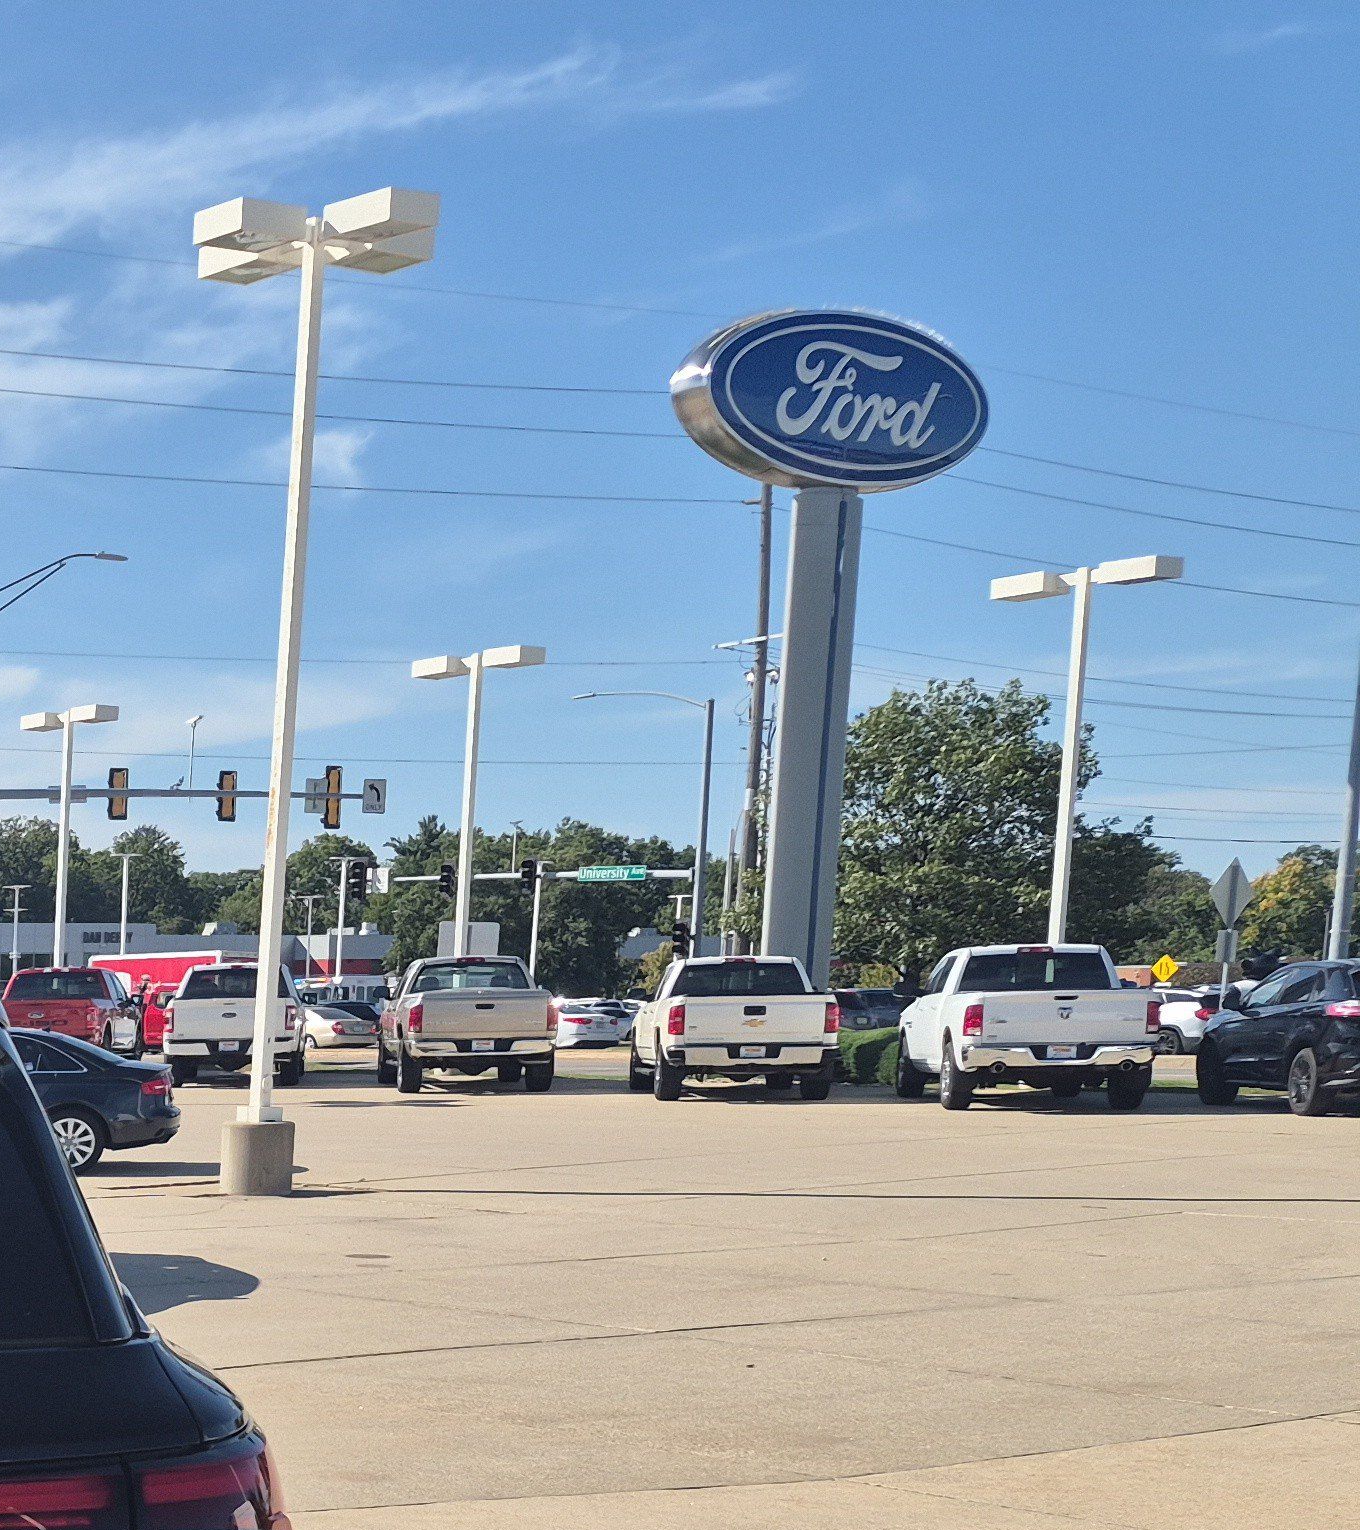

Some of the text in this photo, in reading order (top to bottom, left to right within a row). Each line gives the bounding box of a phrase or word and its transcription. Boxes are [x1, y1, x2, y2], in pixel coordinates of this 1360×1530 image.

[775, 340, 943, 450] Ford
[579, 866, 645, 880] University Ave
